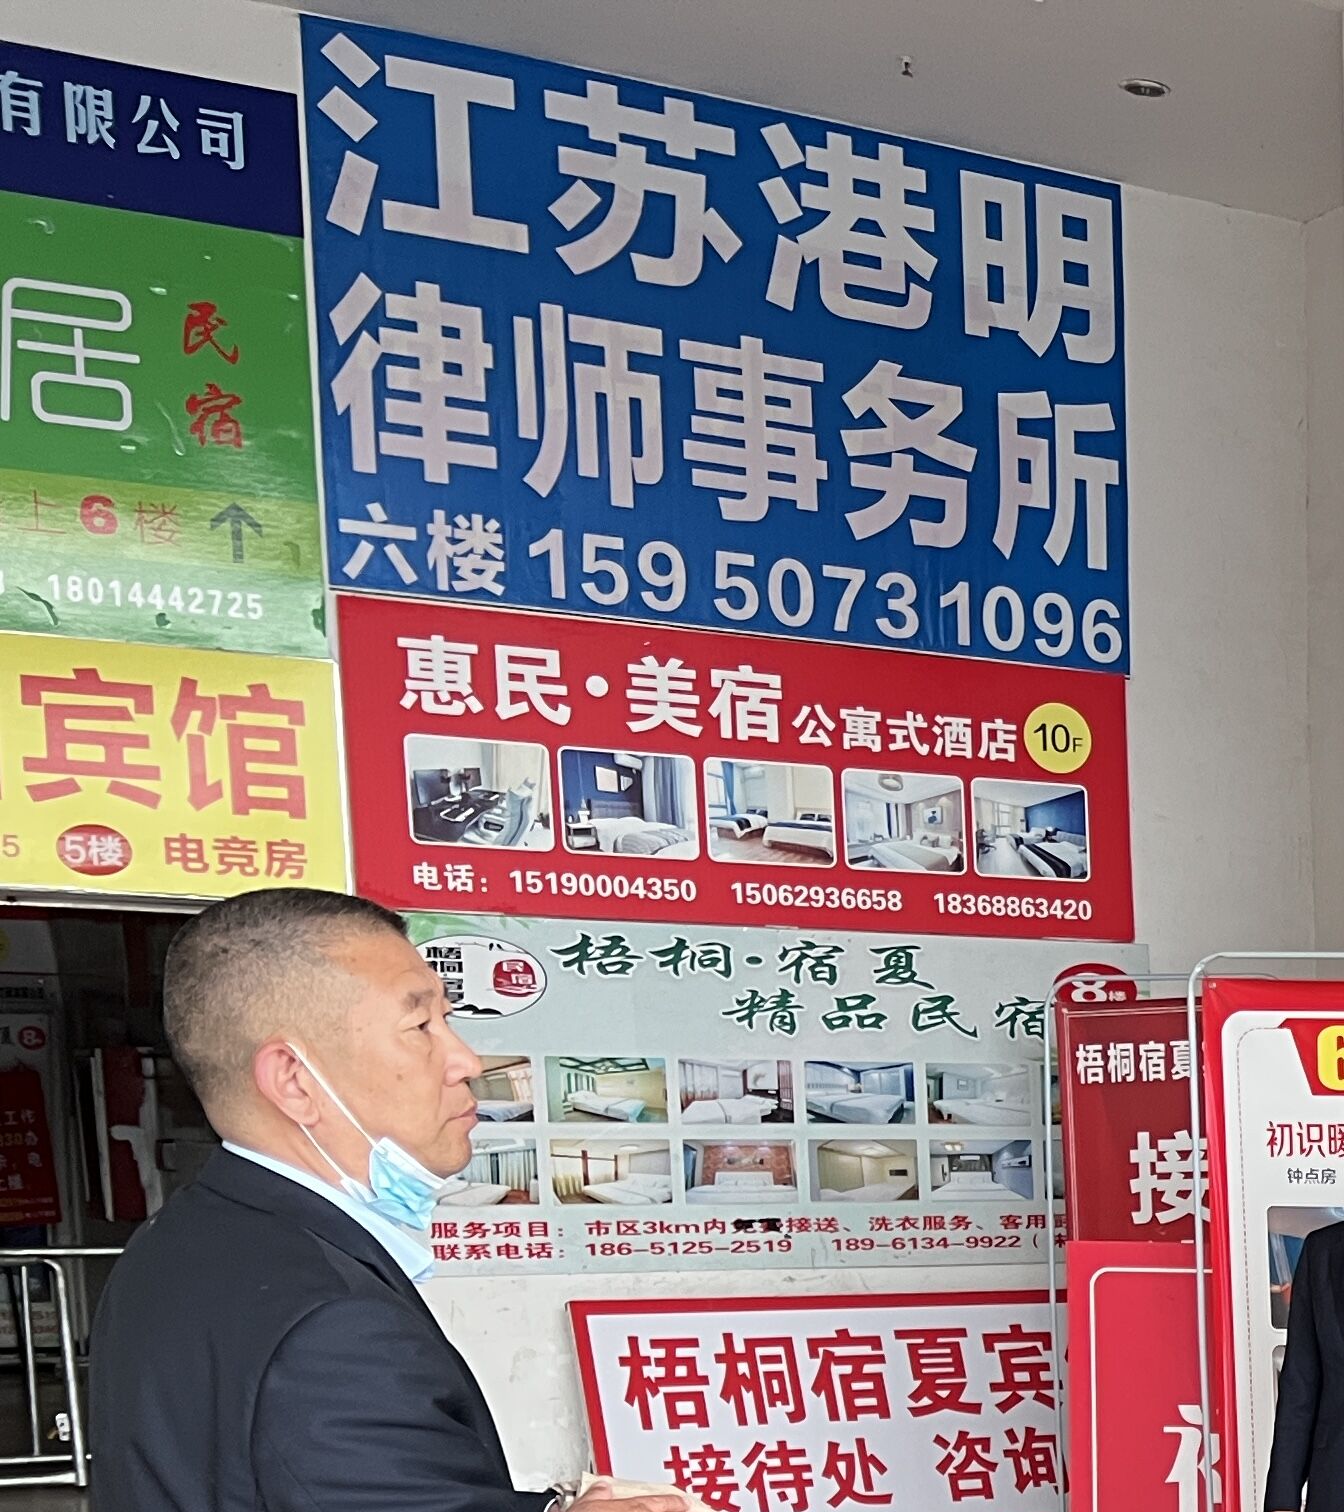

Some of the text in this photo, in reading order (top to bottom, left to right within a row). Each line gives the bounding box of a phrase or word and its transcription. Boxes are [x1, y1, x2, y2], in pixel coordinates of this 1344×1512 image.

[0, 70, 245, 171] 有限公司
[317, 32, 1117, 364] 江苏港明
[329, 271, 1120, 571] 律师事务所
[47, 572, 265, 621] 18014442725
[338, 502, 1123, 664] 六楼 159 5073 1096
[20, 667, 307, 820] 宾馆
[791, 703, 1018, 763] 公寓式酒店
[63, 835, 125, 867] 5楼
[163, 832, 308, 880] 电竞房
[508, 869, 697, 902] 15190004350
[731, 882, 903, 911] 15062936658
[933, 892, 1092, 920] 18368863420
[722, 987, 1050, 1039] 精品民宿
[1076, 1040, 1206, 1085] 梧桐宿夏
[1287, 1167, 1337, 1185] 钟点房
[618, 1322, 1069, 1432] 梧桐宿夏宾
